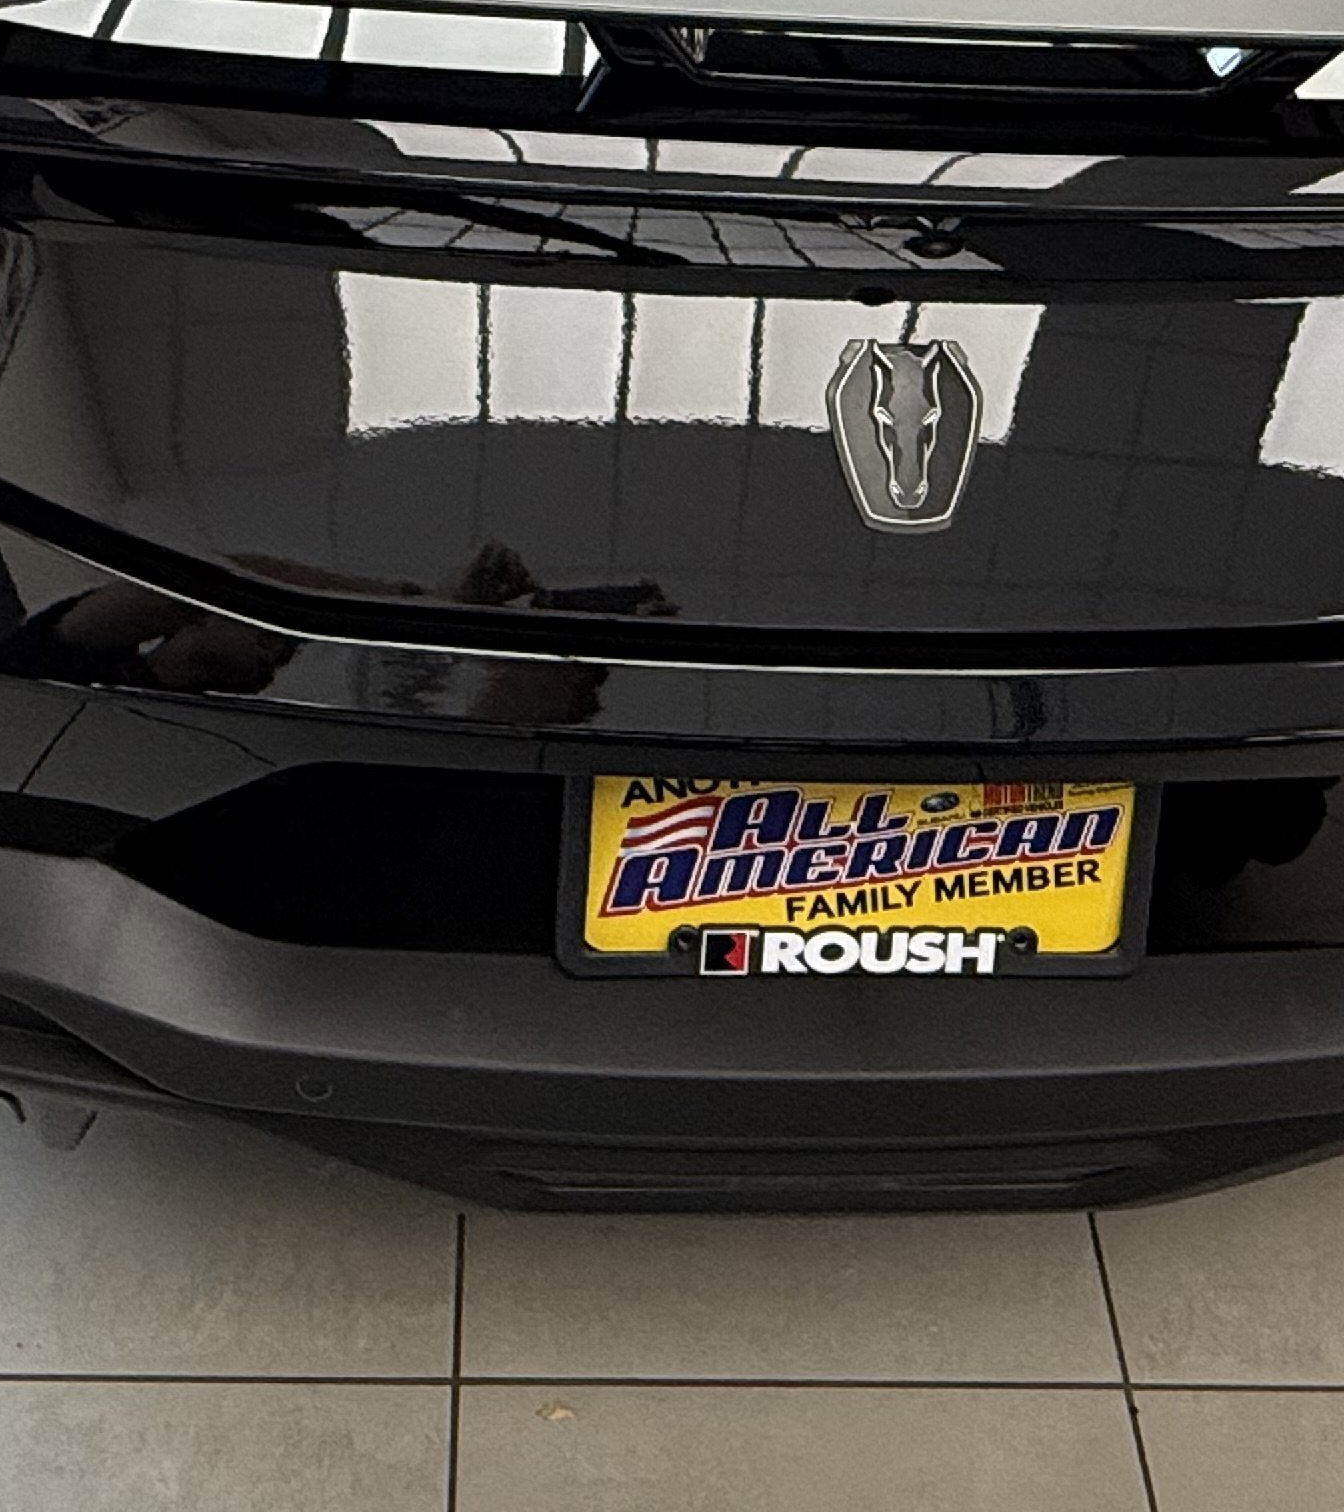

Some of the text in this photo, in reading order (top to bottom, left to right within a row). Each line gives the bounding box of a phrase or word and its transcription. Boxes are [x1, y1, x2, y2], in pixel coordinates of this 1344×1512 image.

[786, 858, 1102, 921] FAMILY MEMBER
[761, 930, 998, 974] ROUSH
